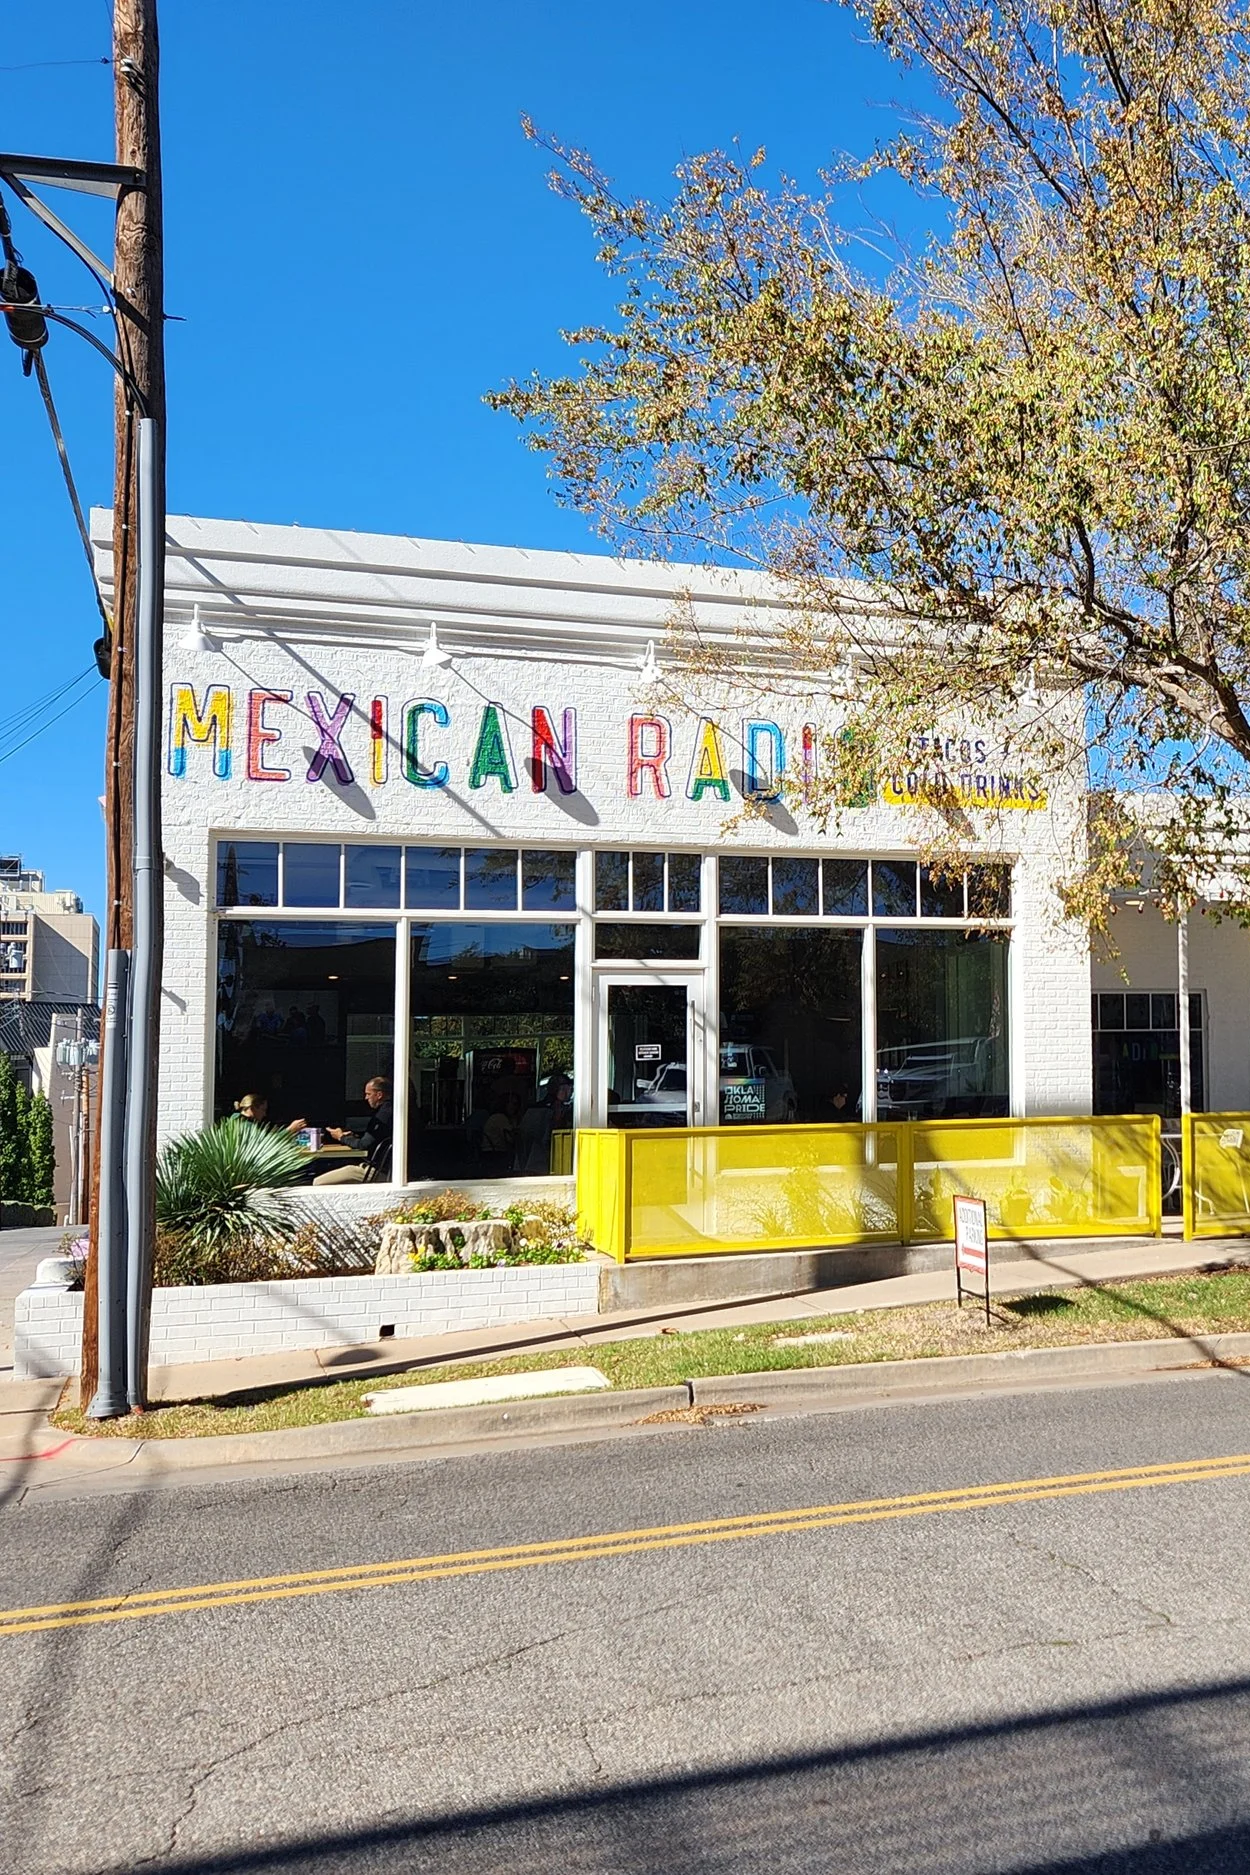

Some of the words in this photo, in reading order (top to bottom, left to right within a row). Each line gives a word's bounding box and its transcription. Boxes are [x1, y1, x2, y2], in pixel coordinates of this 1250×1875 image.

[167, 681, 579, 795] MEXICAN
[960, 774, 1042, 800] DRINKS
[724, 1085, 754, 1094] OKLA
[724, 1095, 761, 1104] HOMA
[724, 1104, 766, 1113] PRIDE
